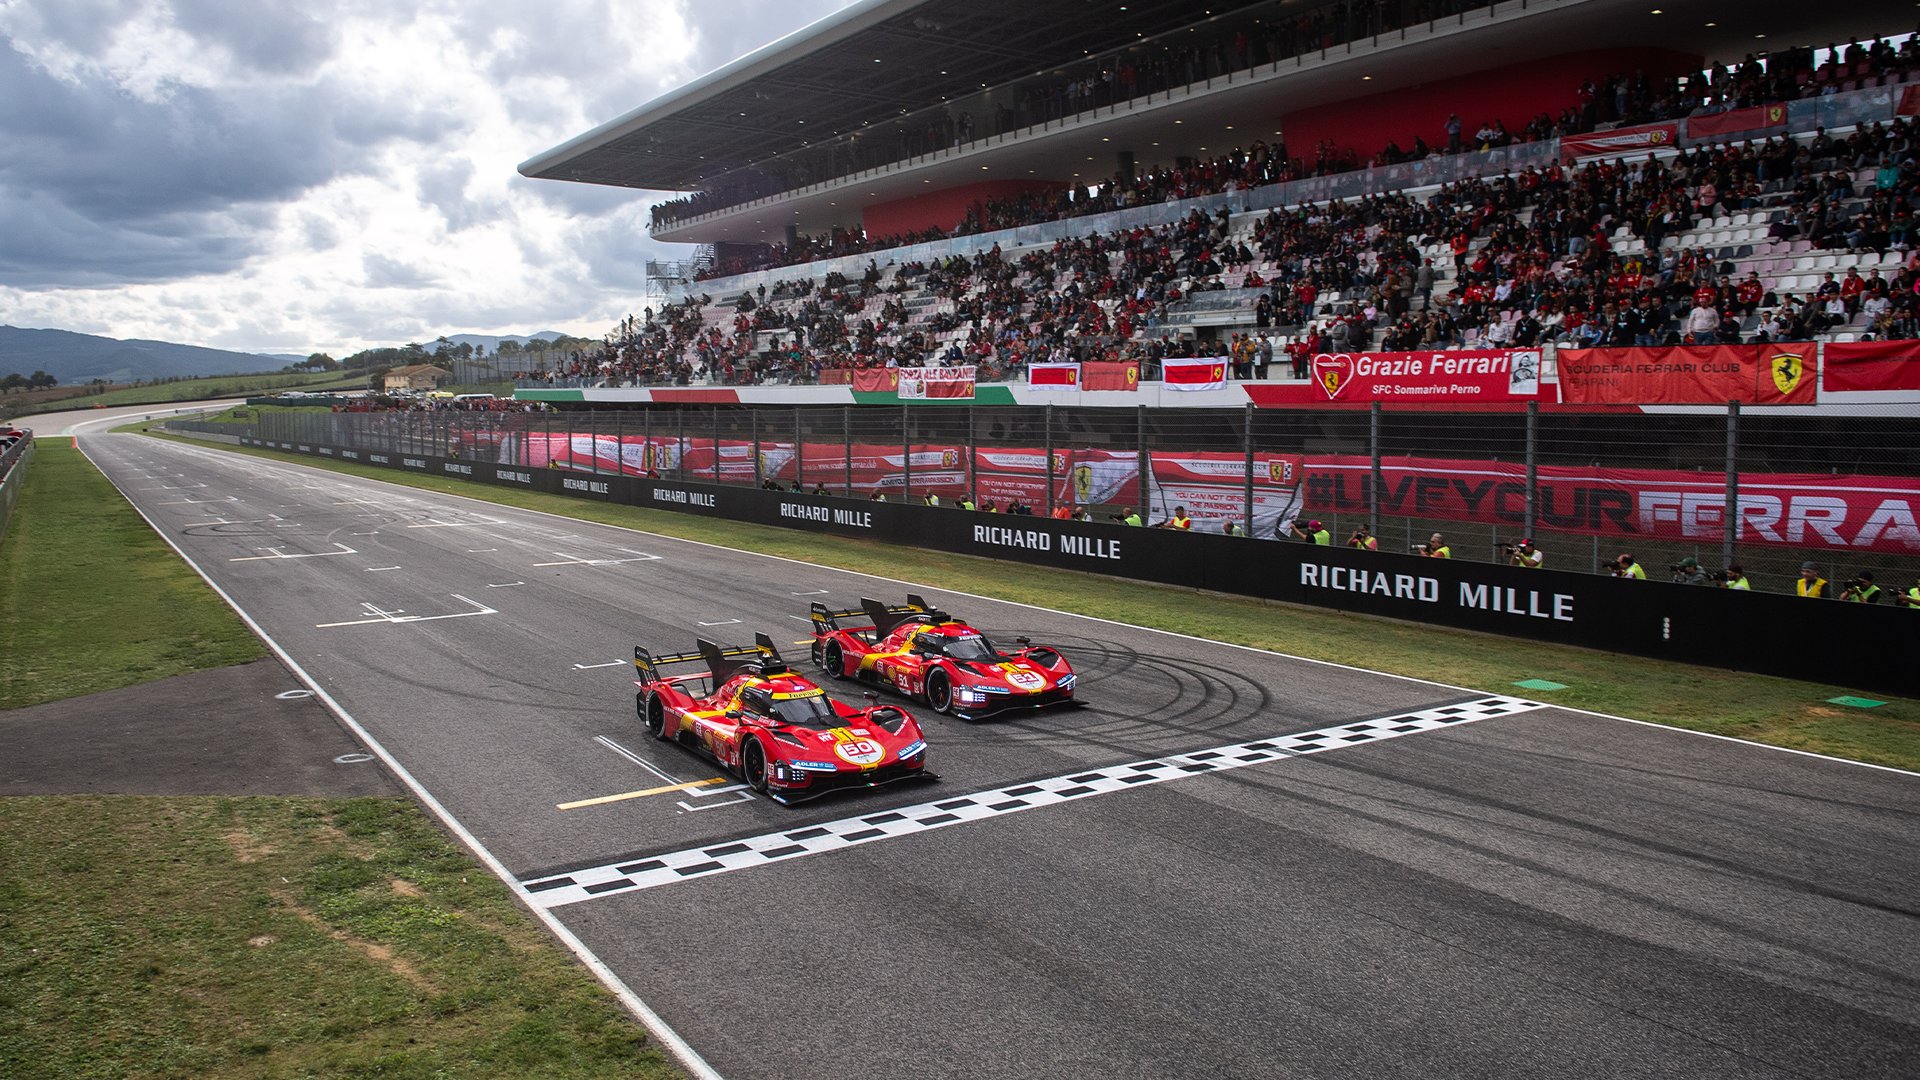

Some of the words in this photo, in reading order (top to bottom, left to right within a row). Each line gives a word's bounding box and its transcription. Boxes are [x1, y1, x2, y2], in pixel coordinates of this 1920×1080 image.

[1357, 356, 1428, 376] Grazie
[1429, 352, 1510, 375] Ferrari
[1567, 364, 1632, 375] SCUDERIA
[1636, 363, 1697, 374] FERRARI
[1701, 363, 1740, 373] CLUB
[1372, 385, 1391, 394] SFC
[1394, 384, 1447, 395] Sommariva
[1450, 384, 1481, 394] Perno
[497, 470, 515, 480] RICHARD
[516, 472, 531, 483] MILLE
[563, 478, 588, 491] RICHARD
[589, 481, 608, 494] MILLE
[653, 488, 686, 503] RICHARD
[689, 492, 715, 507] MILLE
[1226, 494, 1266, 503] DESCIBE
[780, 502, 829, 522] RICHARD
[834, 509, 872, 528] MILLE
[974, 525, 1050, 551] RICHARD
[1060, 534, 1121, 560] MILLE
[1300, 562, 1438, 603] RICHARD
[1459, 581, 1574, 622] MILLE
[898, 673, 908, 688] 51
[1013, 671, 1038, 683] 51
[843, 742, 873, 755] 50
